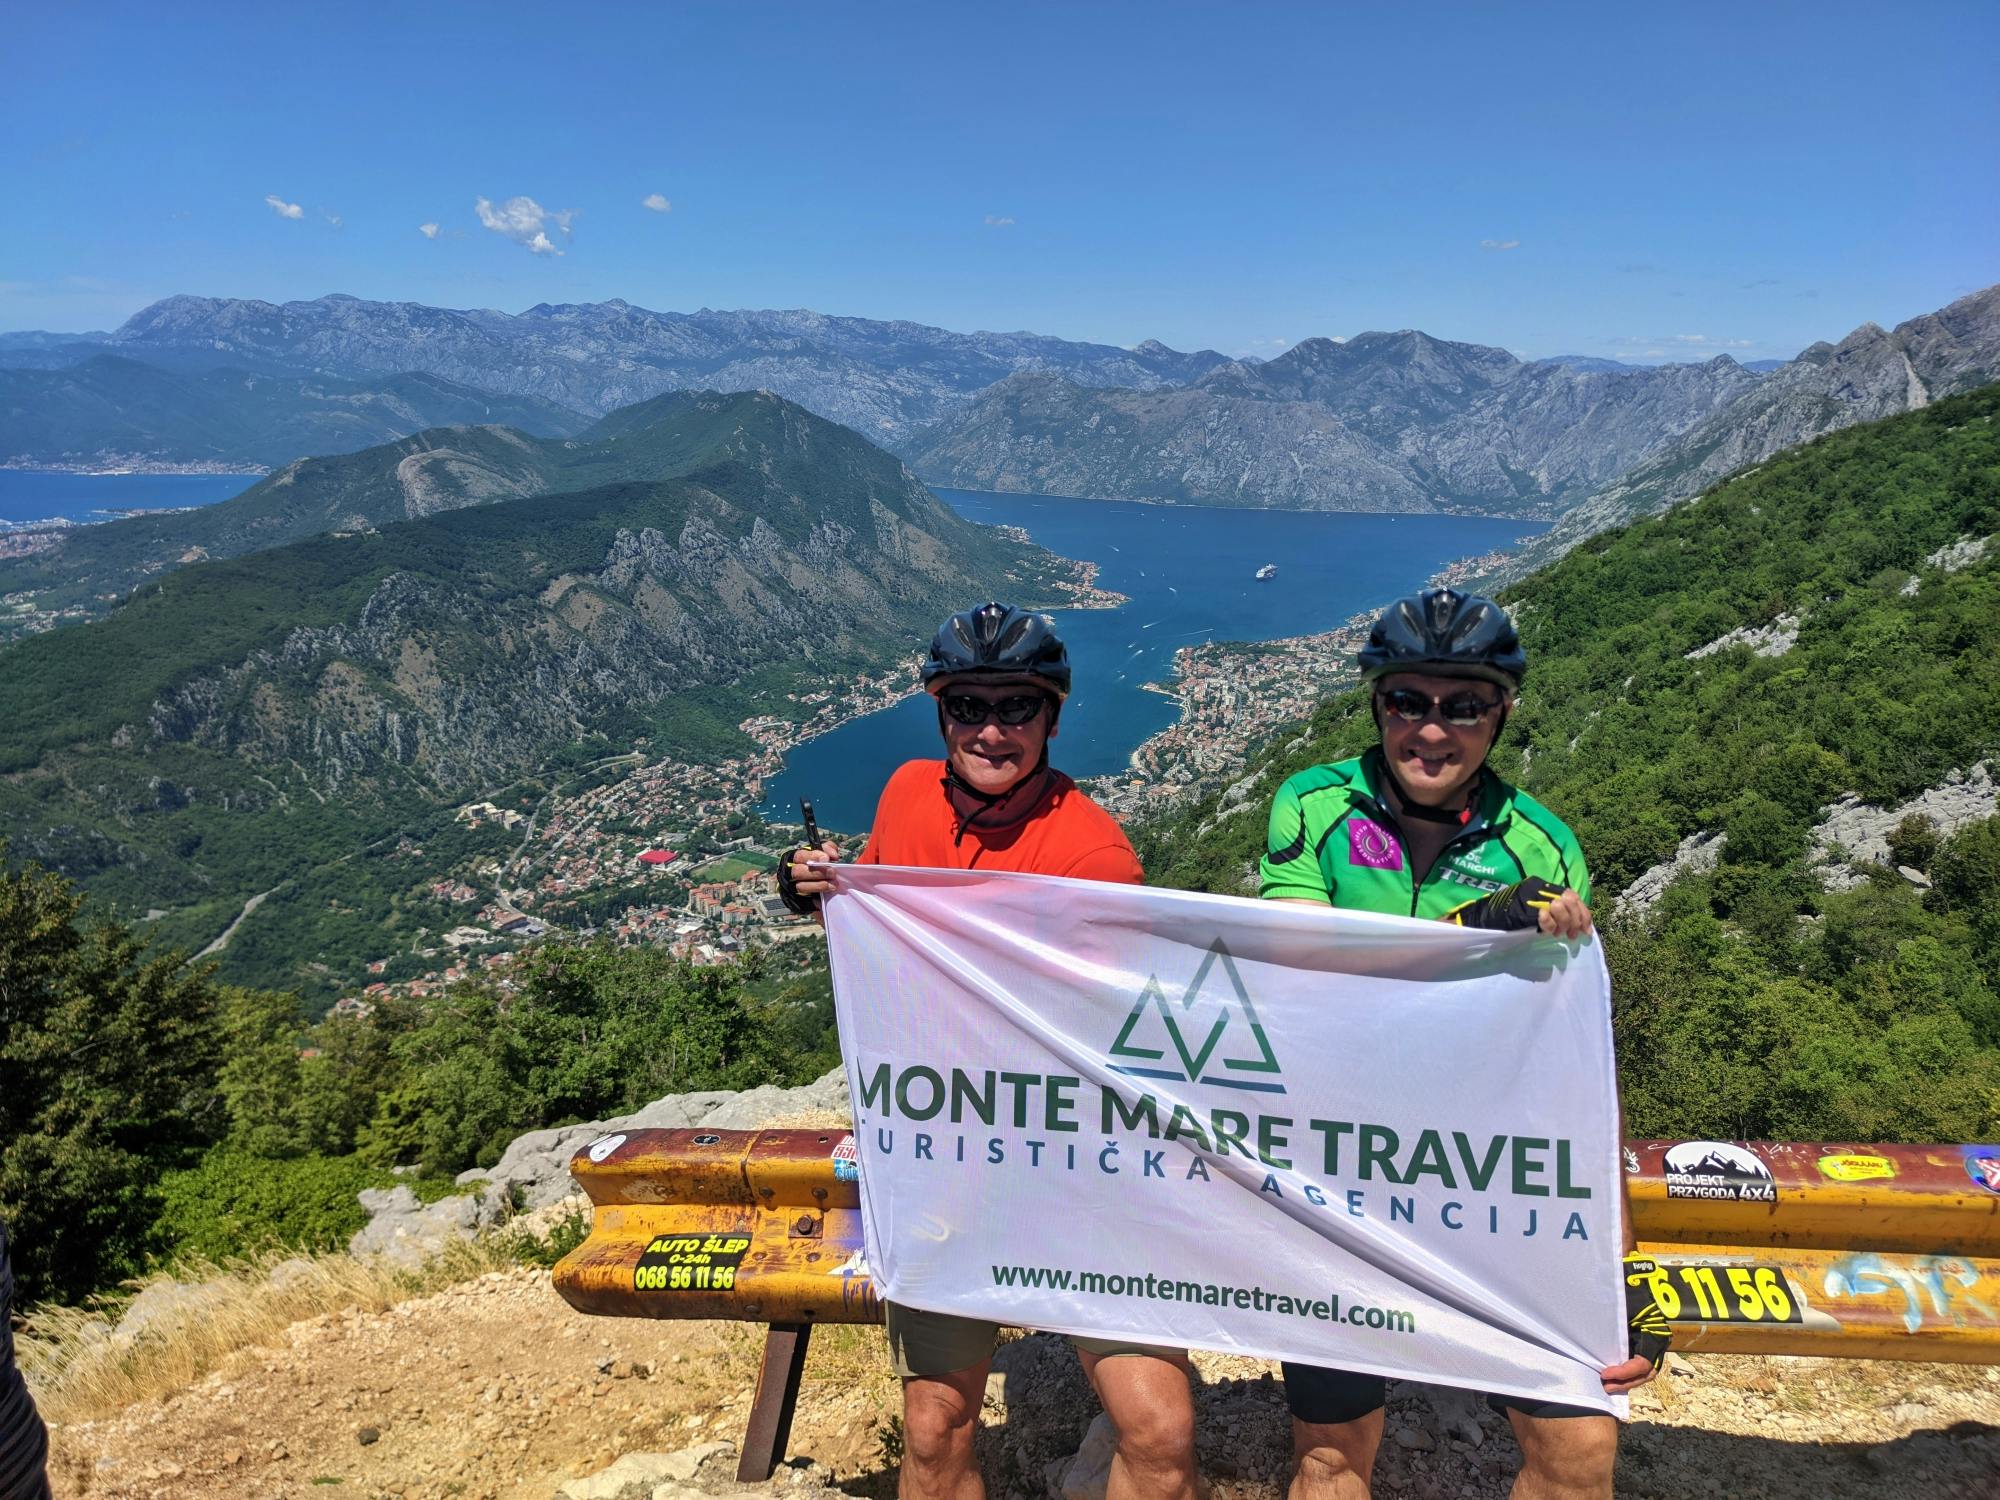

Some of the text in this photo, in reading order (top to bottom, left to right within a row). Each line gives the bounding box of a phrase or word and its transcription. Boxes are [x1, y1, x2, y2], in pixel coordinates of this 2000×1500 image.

[1449, 856, 1495, 875] MARCHI
[1465, 852, 1482, 864] DE
[857, 1056, 1592, 1200] MONTE MARE TRAVEL
[862, 1120, 1589, 1241] URISTIČKA AGENCIJA
[1666, 1173, 1725, 1186] PROJEKT
[1668, 1183, 1775, 1201] PRZYGODA 4x4
[647, 1235, 749, 1253] AUTO ŠLEP
[669, 1254, 711, 1264] 0-24h
[635, 1265, 735, 1289] 068 56 11 56
[992, 1264, 1416, 1333] www.montemaretravel.com
[1679, 1267, 1730, 1320] 11
[1728, 1267, 1792, 1321] 56
